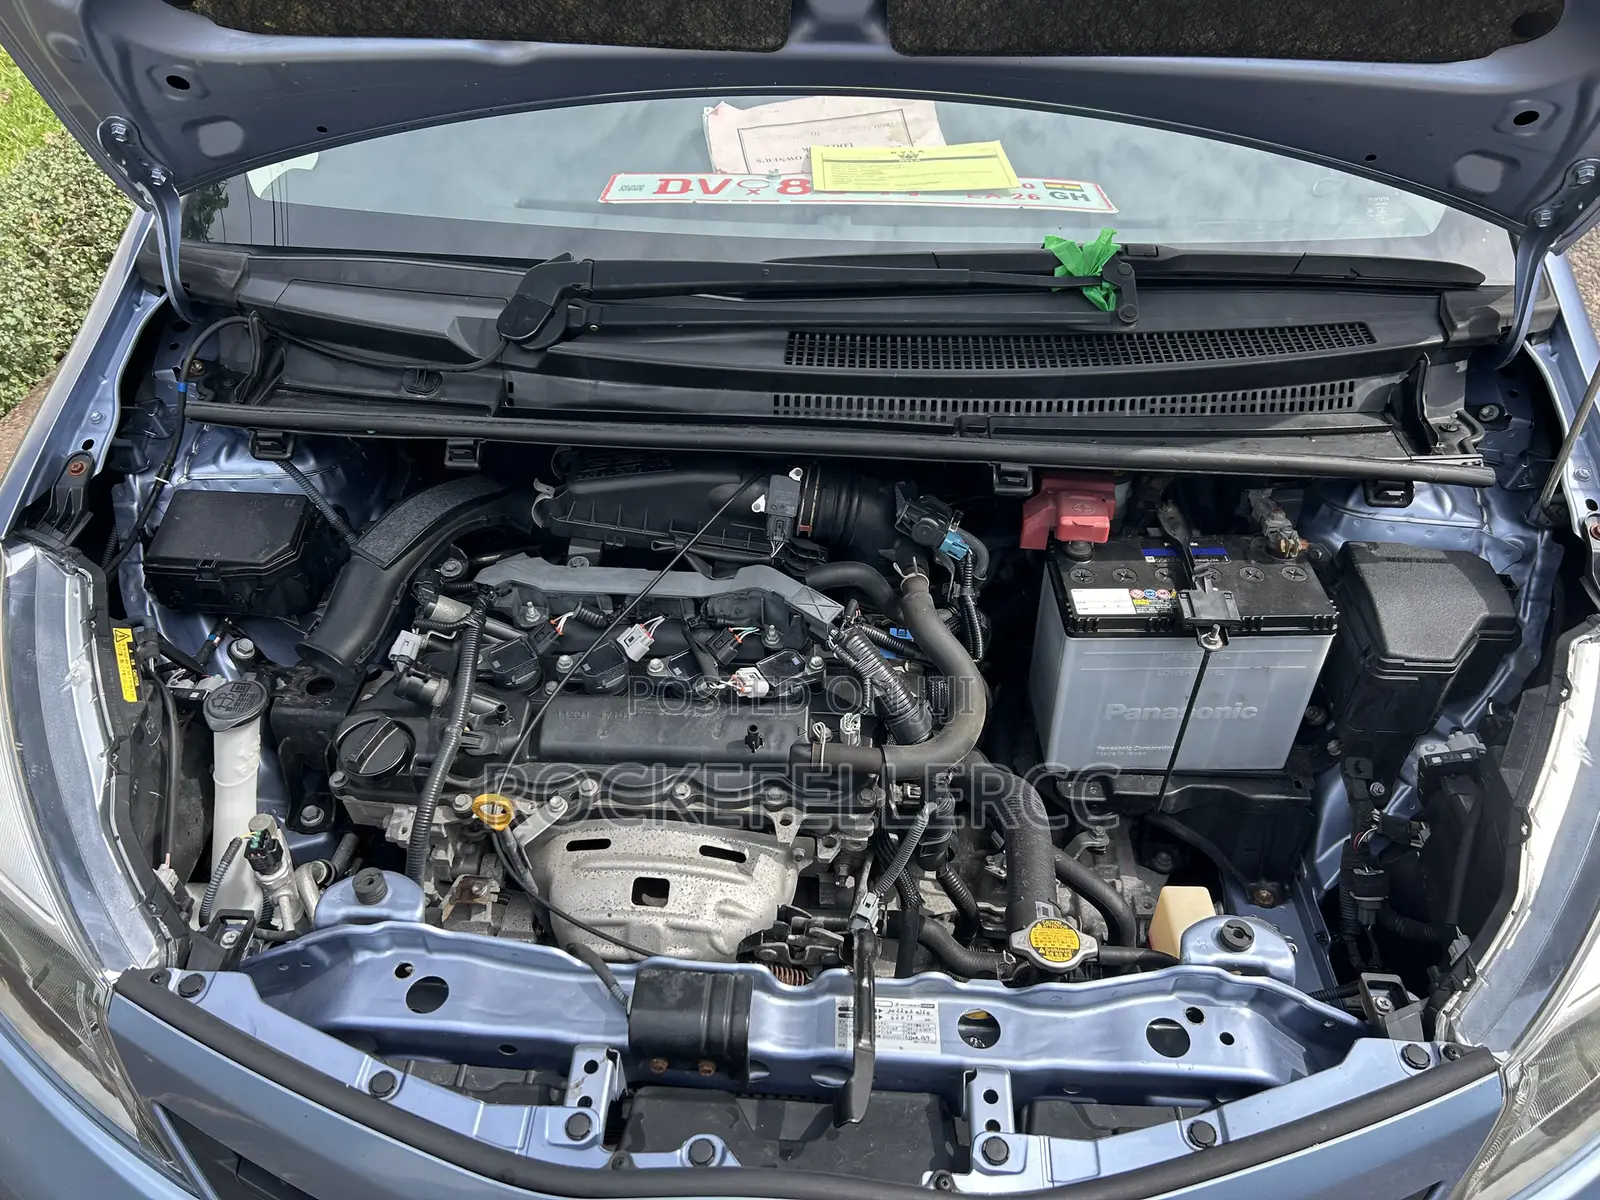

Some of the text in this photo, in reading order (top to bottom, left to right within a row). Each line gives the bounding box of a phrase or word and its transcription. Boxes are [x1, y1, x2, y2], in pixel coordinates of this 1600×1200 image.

[652, 178, 733, 195] DV
[1049, 190, 1091, 202] GH
[1104, 701, 1259, 721] Panasonic
